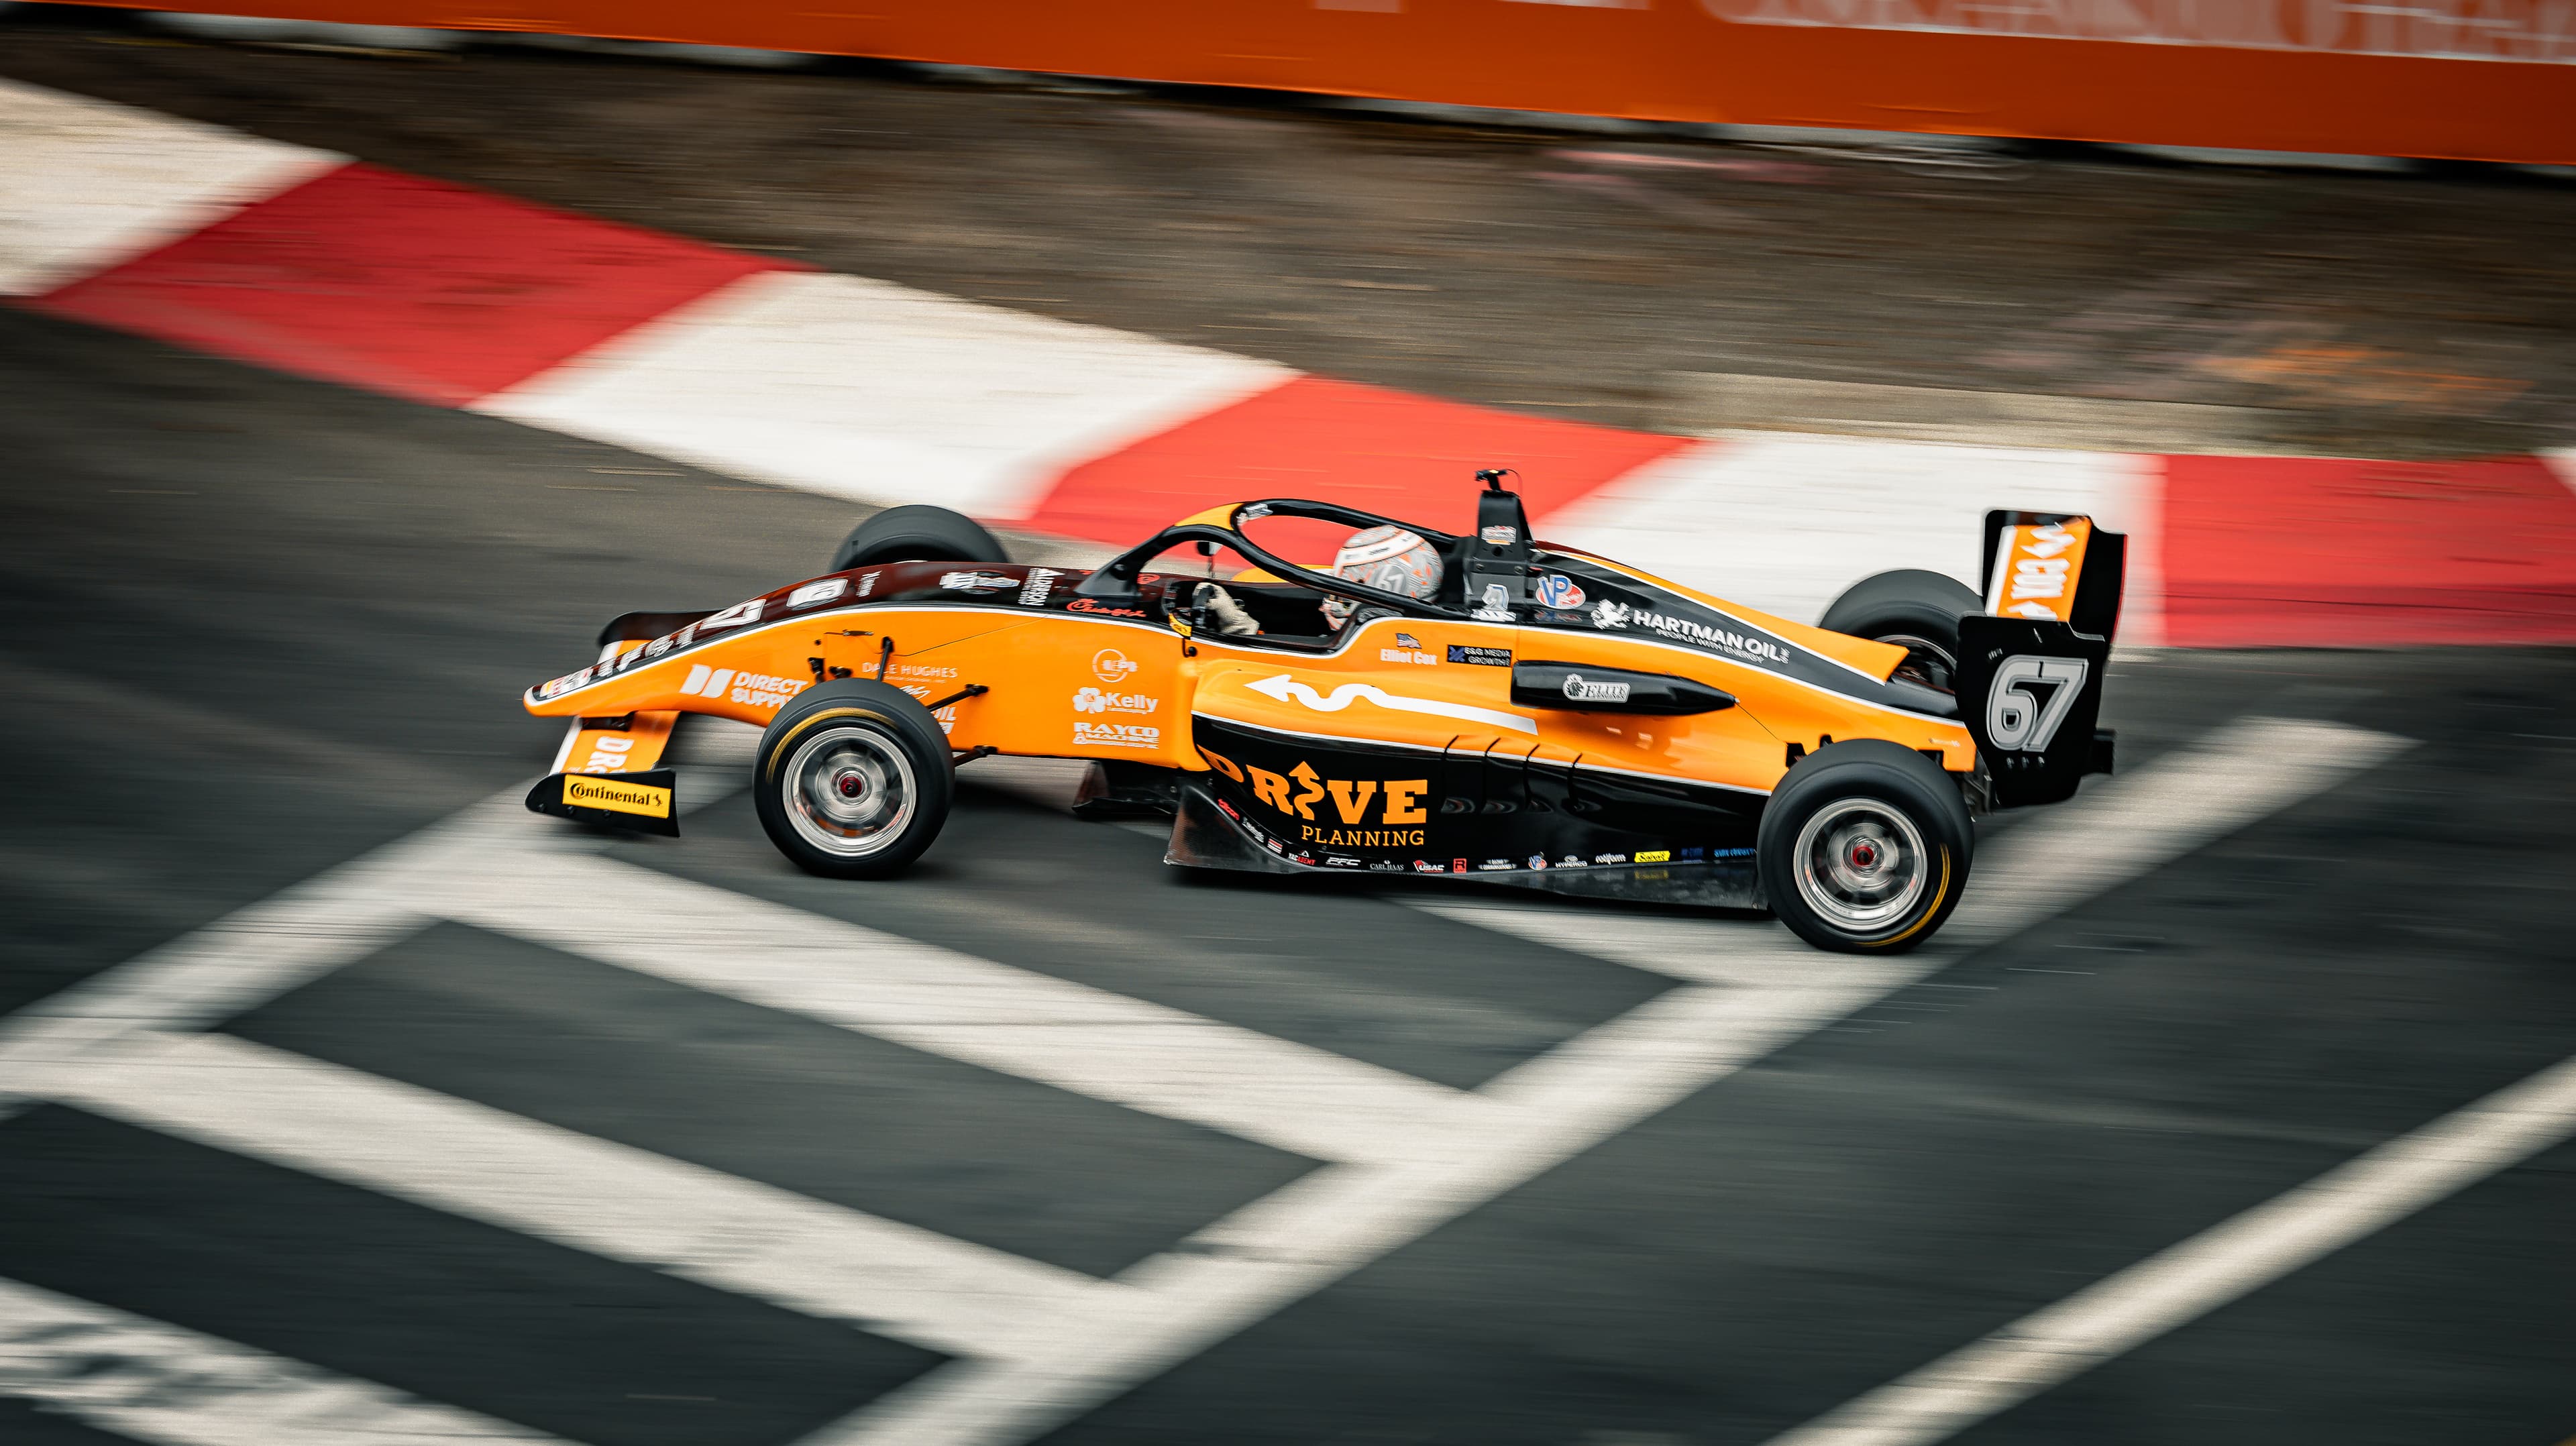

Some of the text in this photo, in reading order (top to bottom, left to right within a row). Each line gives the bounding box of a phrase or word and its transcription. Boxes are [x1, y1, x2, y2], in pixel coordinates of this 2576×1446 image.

[1633, 610, 1743, 649] HARTMAN
[1744, 638, 1781, 662] OIL
[1656, 628, 1696, 643] PEOPLE
[1380, 649, 1438, 665] Elliot Cox
[861, 662, 958, 678] DAE HUGHES
[734, 671, 808, 694] DIRECT
[1106, 692, 1159, 713] Kelly
[1986, 655, 2088, 753] 67
[1073, 722, 1160, 737] RAYCO
[1196, 742, 1428, 824] DRIVE
[570, 783, 650, 805] Continental
[1301, 825, 1425, 846] PLANNING
